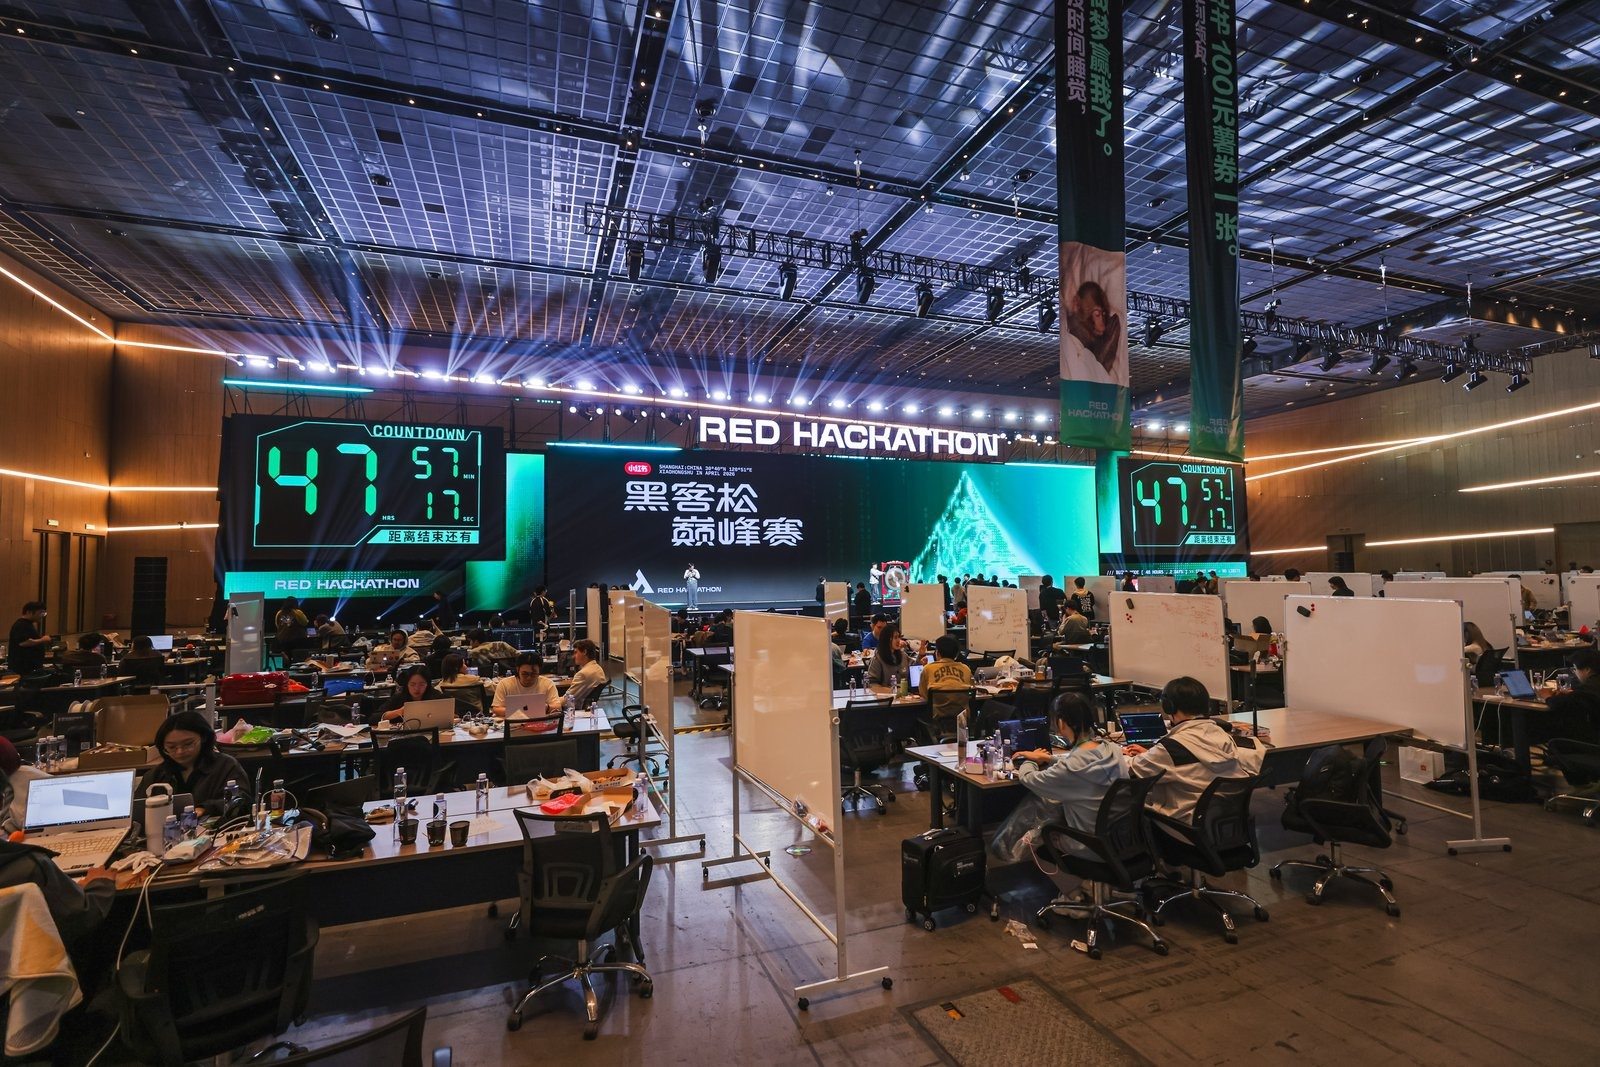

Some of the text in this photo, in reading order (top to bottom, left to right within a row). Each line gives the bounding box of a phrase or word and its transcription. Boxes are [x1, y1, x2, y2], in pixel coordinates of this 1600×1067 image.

[1067, 408, 1122, 421] HACKATHO
[1088, 400, 1108, 410] RED
[372, 425, 465, 441] COUNTDOWN
[700, 416, 999, 457] RED HACKATHON
[412, 446, 459, 479] 57
[1182, 464, 1225, 474] COUNTDOWN
[267, 443, 378, 517] 47
[1201, 478, 1223, 501] 57
[427, 489, 460, 520] 17
[623, 480, 759, 513] 黑客松
[1136, 476, 1189, 527] 47
[1210, 507, 1226, 529] 17
[388, 530, 472, 543] 距离结束还有
[671, 516, 804, 547] 巅峰赛
[1194, 535, 1233, 544] 距离结束还有
[274, 578, 420, 590] RED HACKATHON
